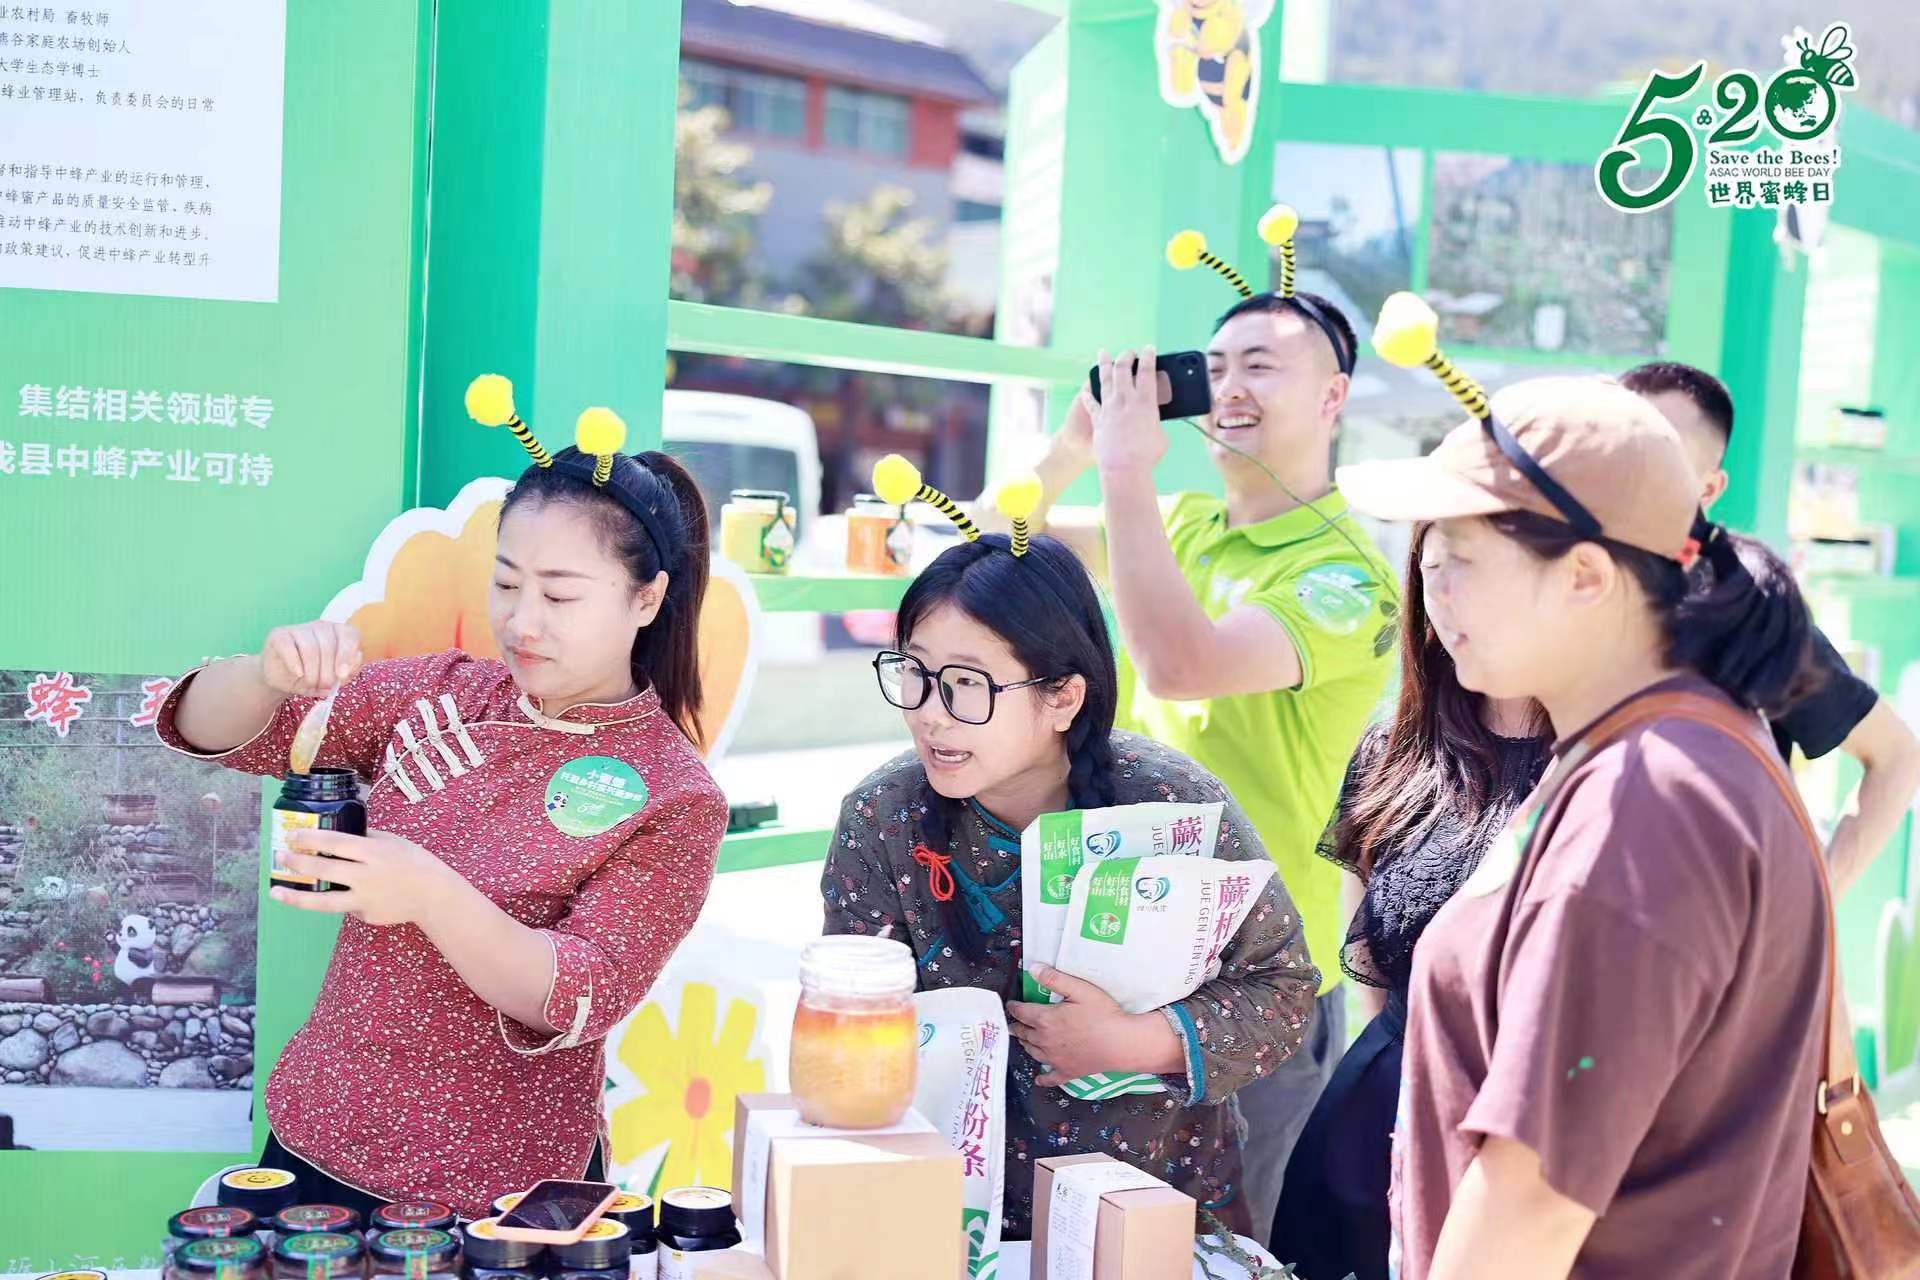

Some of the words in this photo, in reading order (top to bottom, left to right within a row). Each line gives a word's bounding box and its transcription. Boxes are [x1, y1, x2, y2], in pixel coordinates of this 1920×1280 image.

[66, 10, 110, 27] 畜牧师
[0, 188, 212, 217] 蜂蜜产品的质量安全监管、疾病
[0, 241, 211, 267] 政策建议，促进中蜂产业转型升
[18, 383, 274, 429] 集结相关领域专
